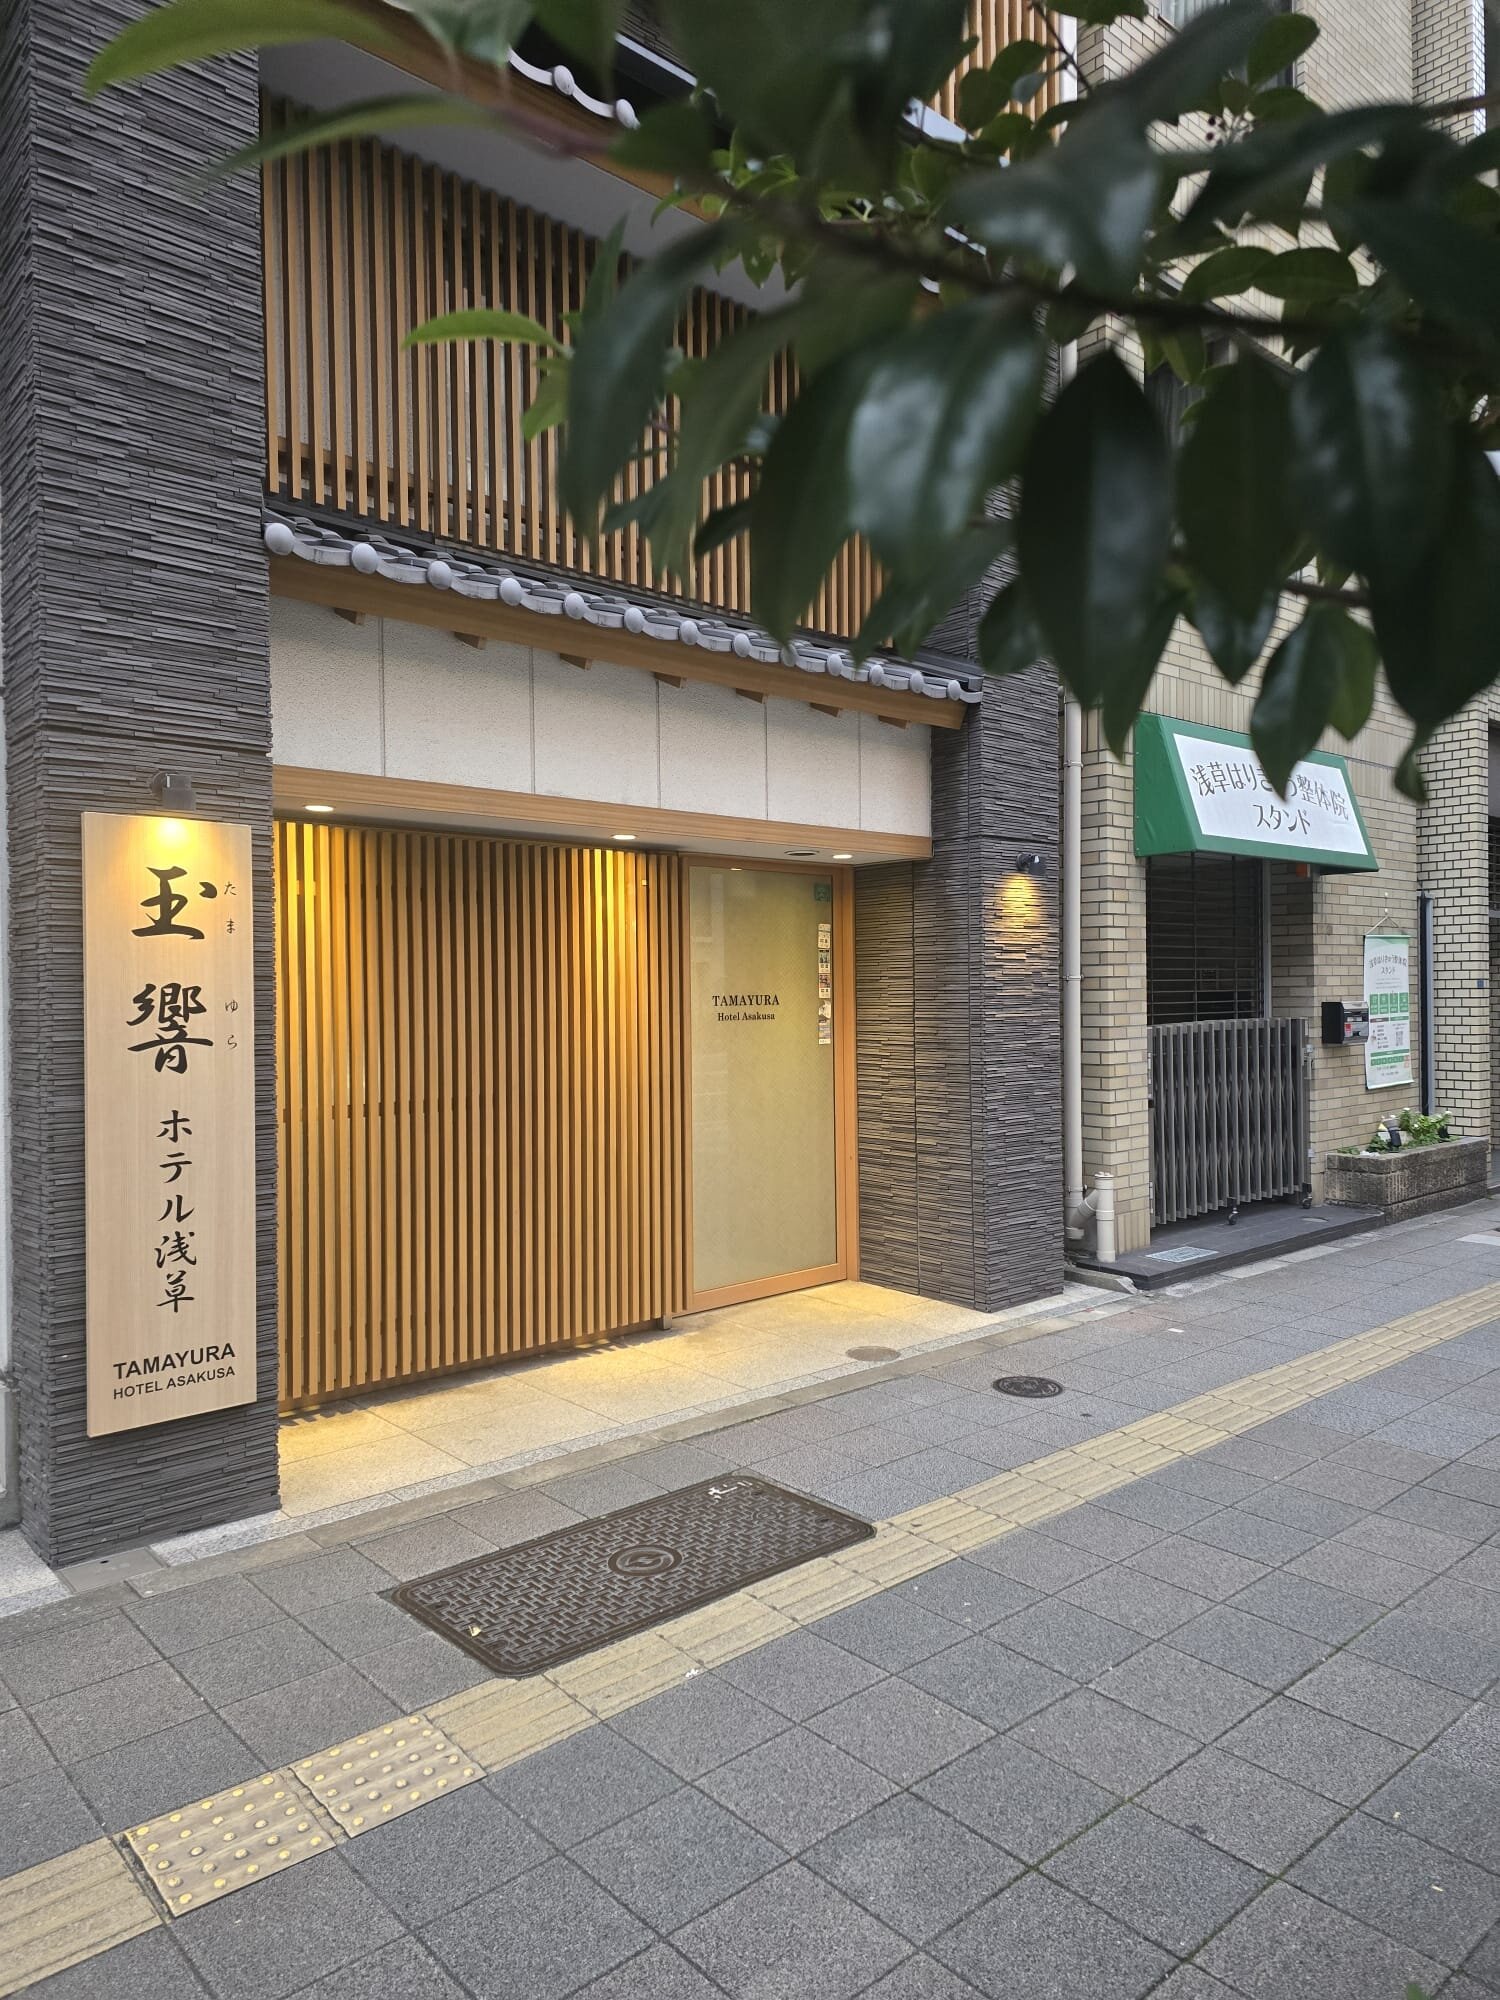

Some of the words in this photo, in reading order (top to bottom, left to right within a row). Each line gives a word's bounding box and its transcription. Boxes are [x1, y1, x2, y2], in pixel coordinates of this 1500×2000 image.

[1253, 804, 1311, 835] スタンド
[127, 866, 218, 1075] 玉響
[712, 994, 780, 1007] TAMAYURA
[717, 1012, 740, 1022] Hotel
[742, 1012, 775, 1021] Asakusa
[154, 1109, 197, 1313] ホテル浅草
[113, 1342, 236, 1380] TAMAYURA
[113, 1380, 163, 1400] HOTEL
[166, 1366, 236, 1389] ASAKUSA
